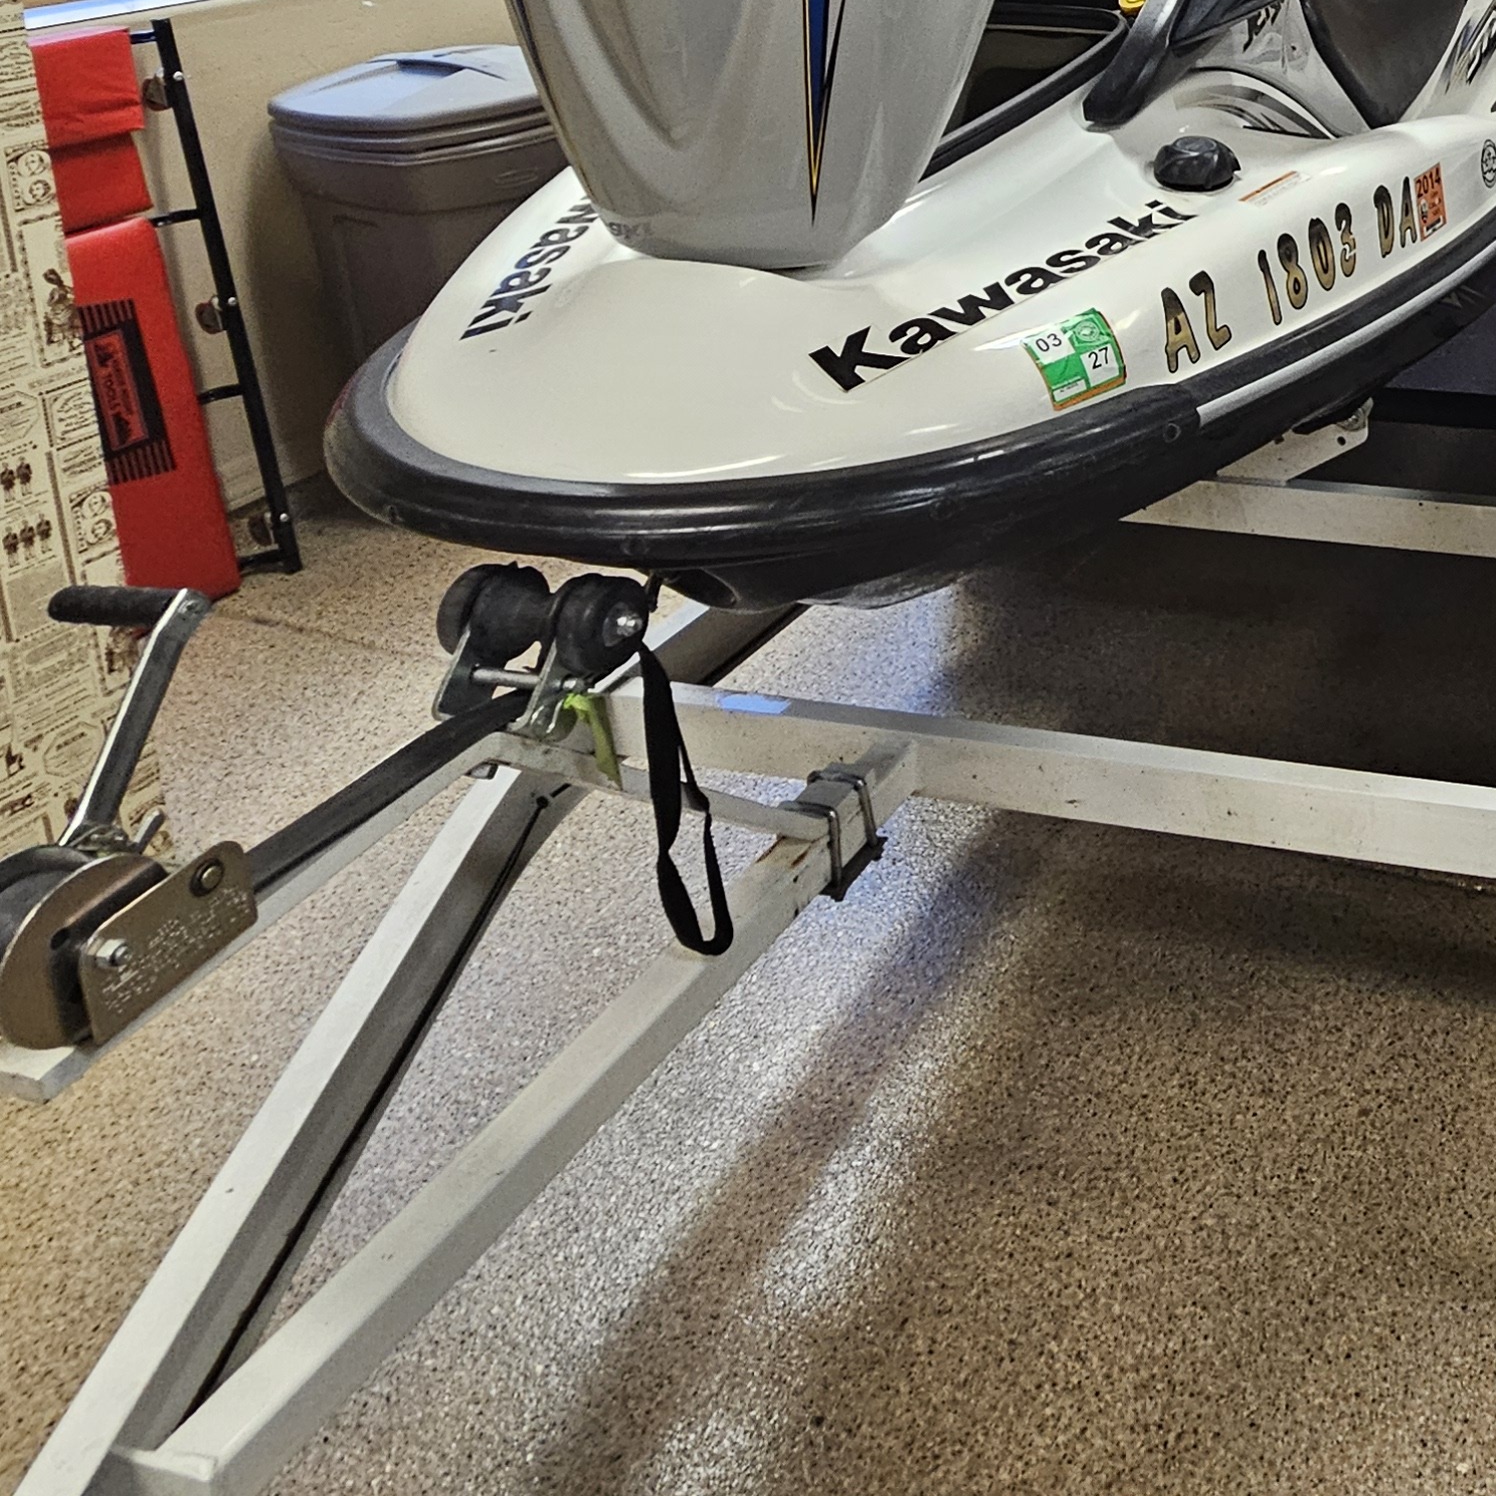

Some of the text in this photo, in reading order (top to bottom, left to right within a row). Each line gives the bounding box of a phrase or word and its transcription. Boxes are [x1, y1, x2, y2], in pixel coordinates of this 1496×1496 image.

[1414, 166, 1441, 199] 2014
[1161, 176, 1418, 374] AZ 1803 DA
[808, 199, 1198, 392] Kawasaki
[1035, 332, 1063, 353] 03
[1088, 346, 1109, 370] 27
